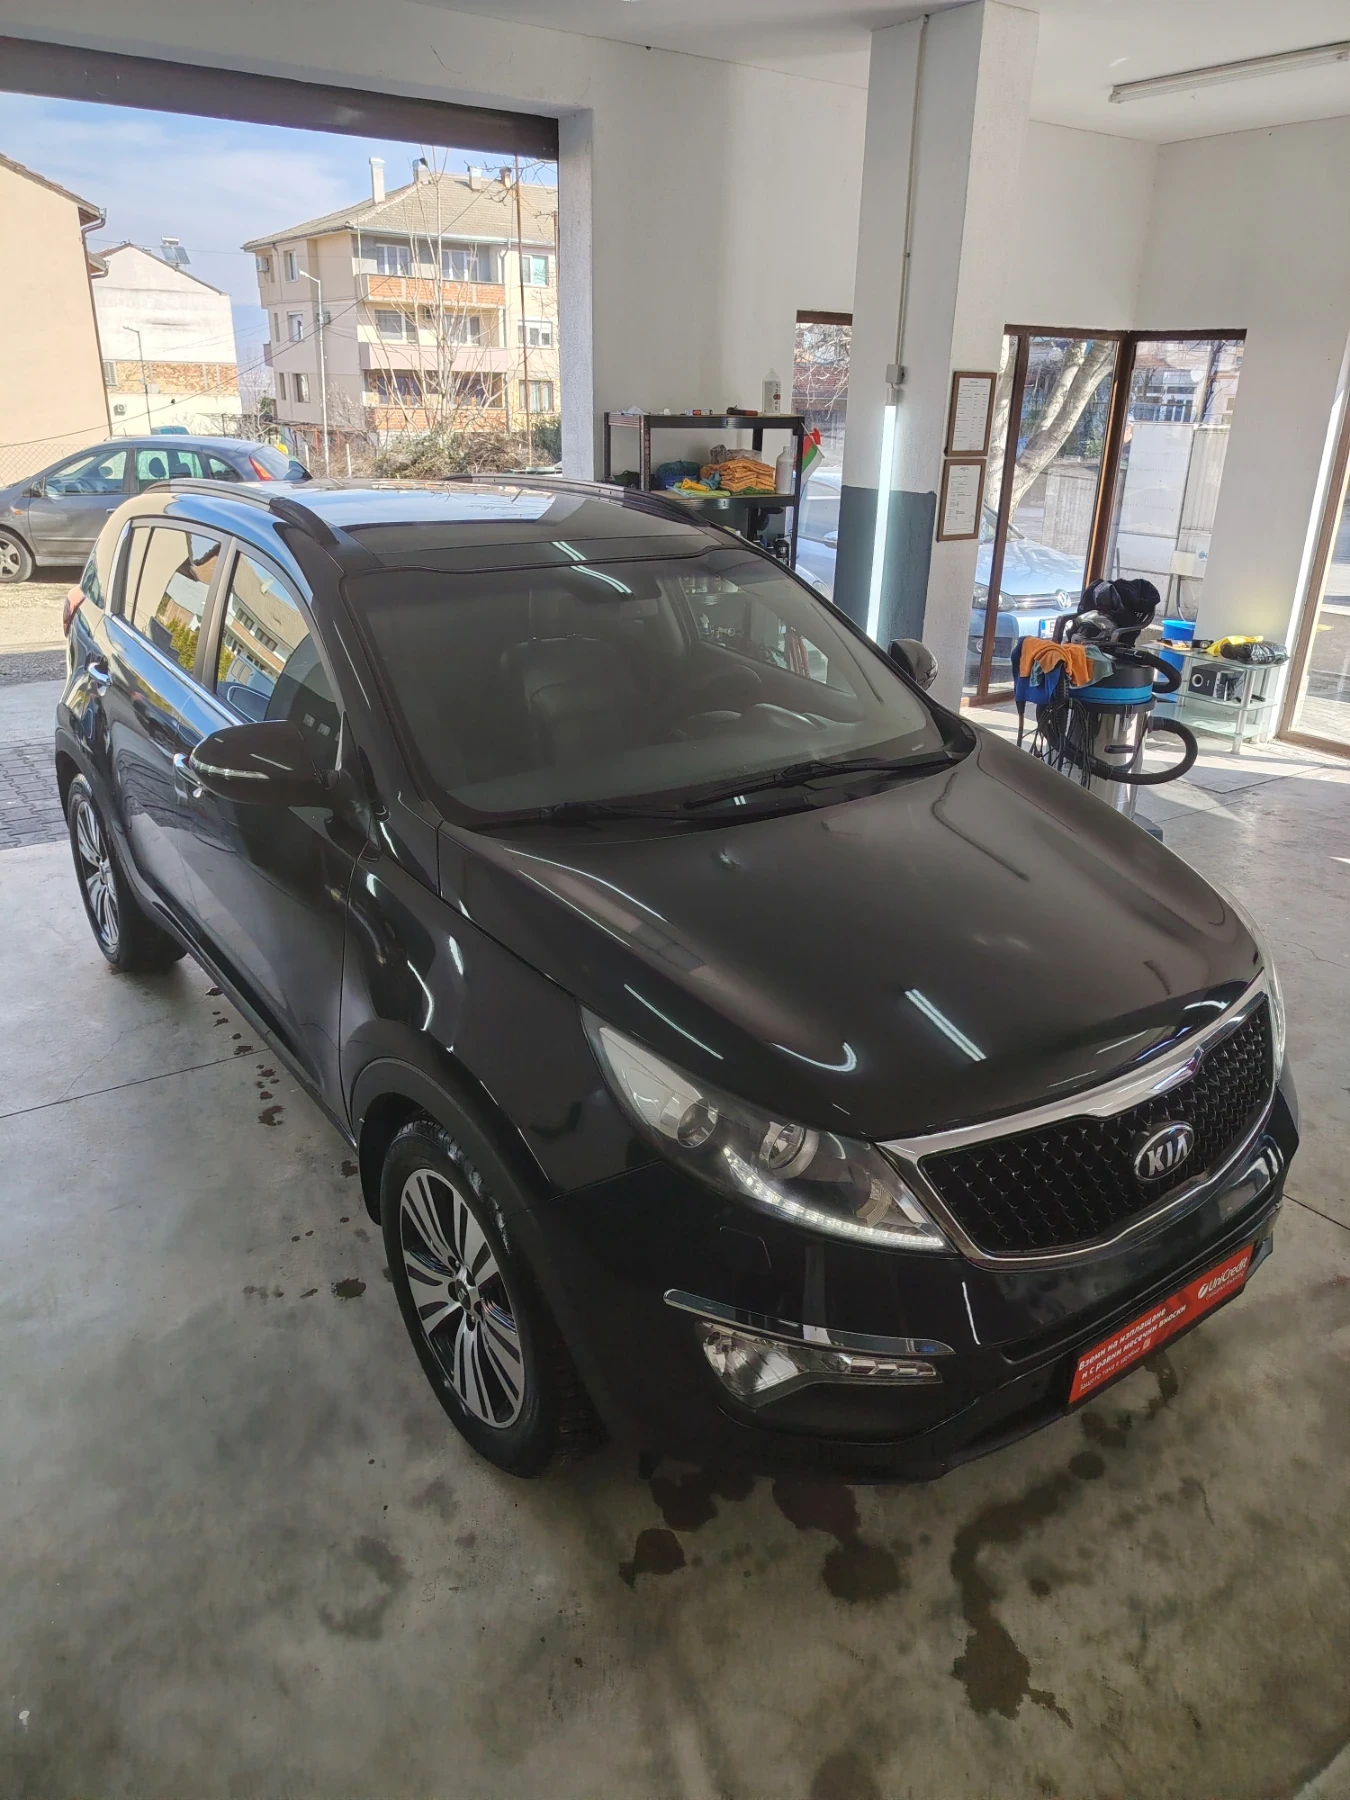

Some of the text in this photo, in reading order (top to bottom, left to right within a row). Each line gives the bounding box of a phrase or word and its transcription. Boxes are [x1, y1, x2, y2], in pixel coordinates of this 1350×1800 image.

[1146, 1133, 1188, 1176] KIA
[1208, 1256, 1248, 1291] UniCredit
[1079, 1308, 1166, 1371] Вземи на изплащане
[1082, 1305, 1187, 1379] и с равни месечни вноски
